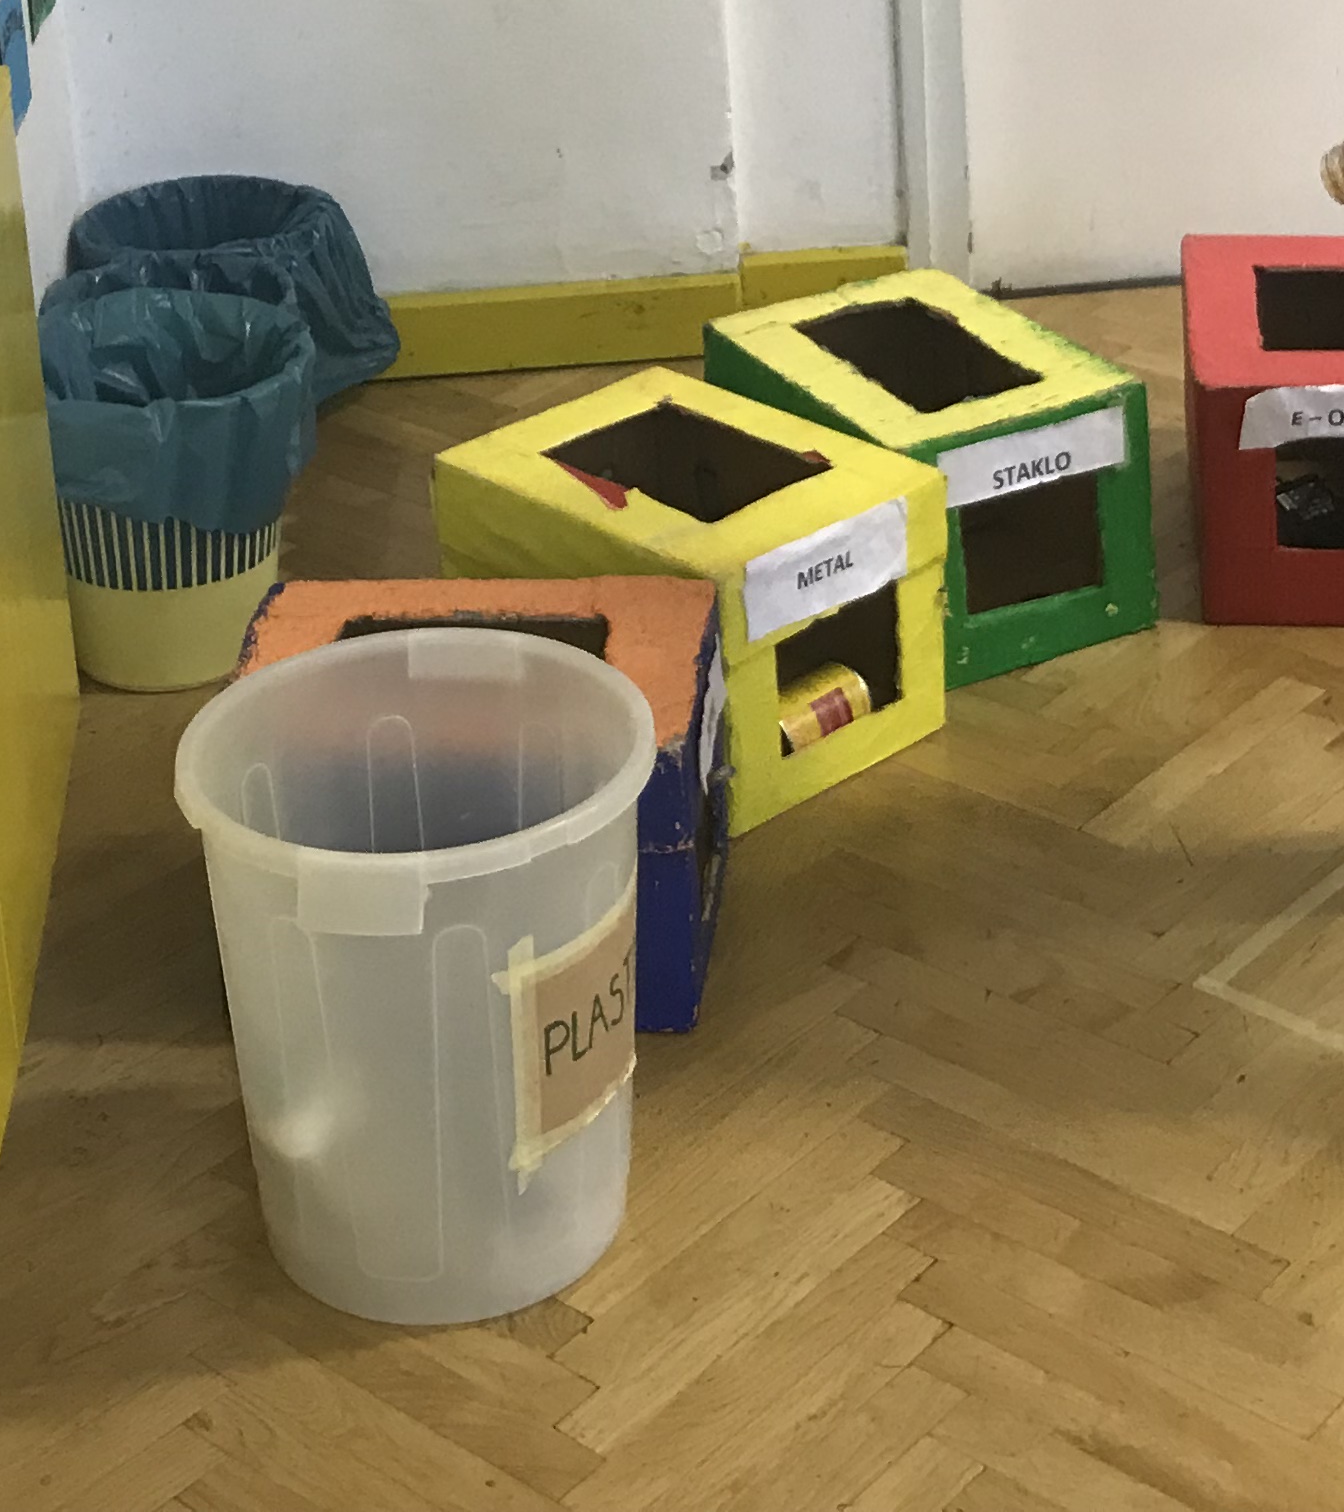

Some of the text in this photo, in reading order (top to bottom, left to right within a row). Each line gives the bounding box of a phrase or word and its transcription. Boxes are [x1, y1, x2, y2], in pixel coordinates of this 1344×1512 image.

[1291, 410, 1303, 426] E
[992, 451, 1071, 490] STAKLO
[797, 550, 854, 590] METAL
